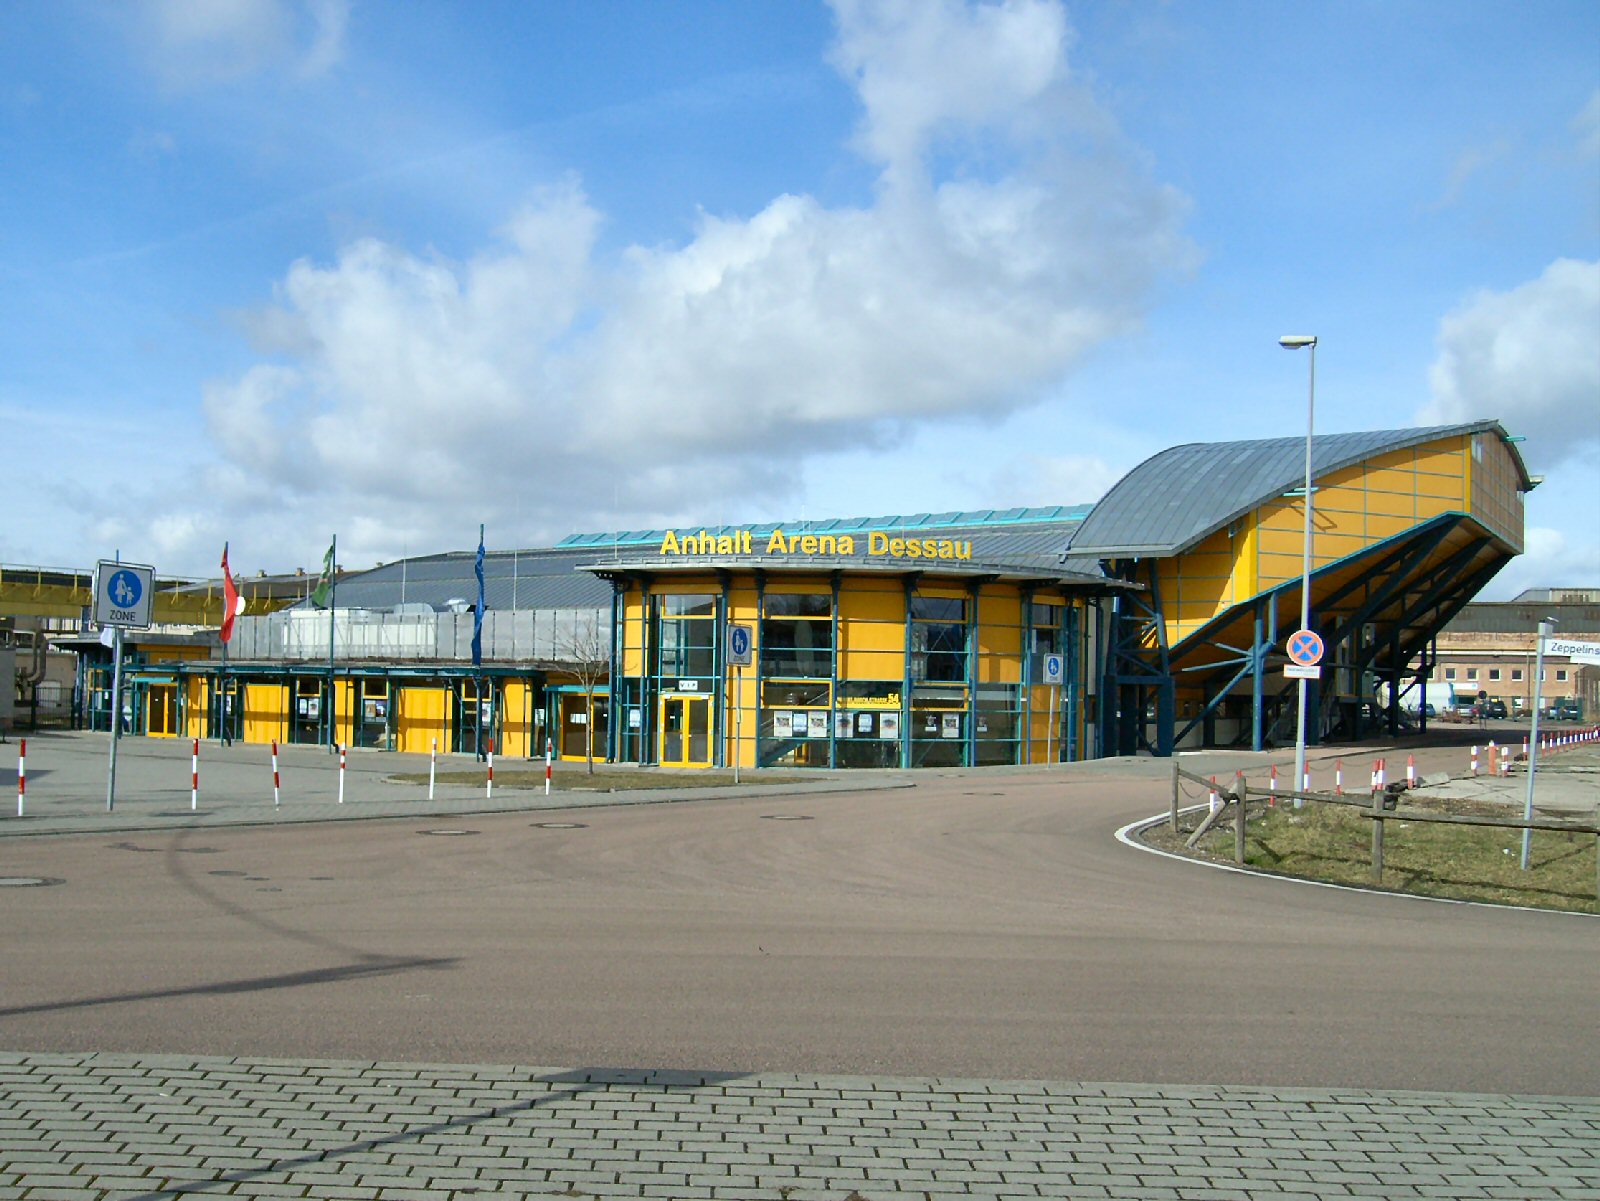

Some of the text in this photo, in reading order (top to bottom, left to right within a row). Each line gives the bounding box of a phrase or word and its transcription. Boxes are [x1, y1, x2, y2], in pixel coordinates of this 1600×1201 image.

[660, 529, 973, 560] Anhalt Arena Dessau
[109, 609, 136, 622] ZONE
[887, 693, 899, 704] 54
